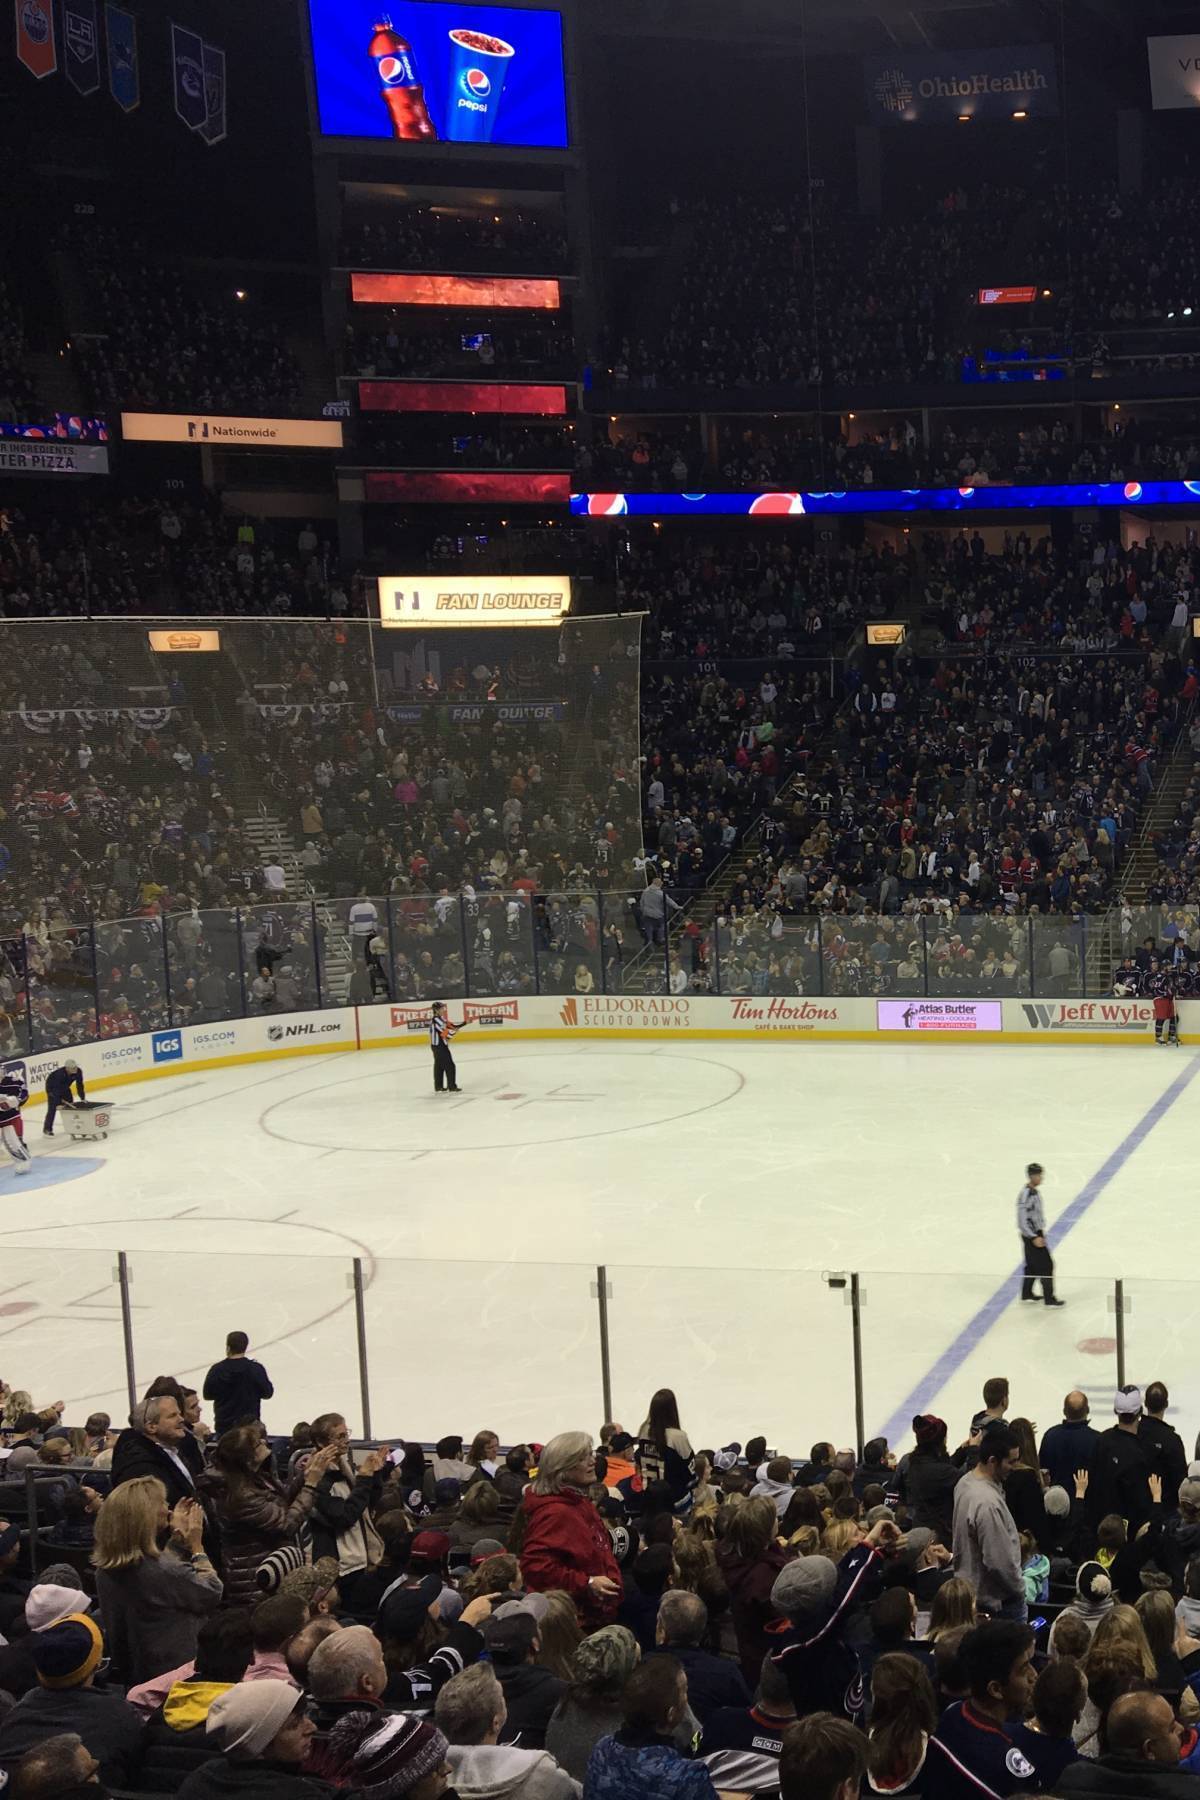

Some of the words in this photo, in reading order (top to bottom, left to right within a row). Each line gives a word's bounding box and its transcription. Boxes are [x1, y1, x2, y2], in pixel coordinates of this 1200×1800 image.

[918, 69, 1048, 98] OhioHealth
[458, 98, 488, 113] pepsi
[212, 426, 276, 438] Nationwide
[32, 455, 78, 469] PIZZA.
[166, 479, 185, 489] 101
[436, 593, 478, 609] FAN
[482, 593, 563, 609] LOUNGE
[698, 662, 717, 673] 101
[1016, 657, 1036, 668] 102
[452, 708, 483, 720] FAN
[584, 998, 690, 1013] ELDORADO
[730, 998, 764, 1019] Tim
[919, 1005, 943, 1014] Atlas
[945, 1005, 977, 1014] Butler
[1060, 1003, 1096, 1022] Jeff
[584, 1015, 638, 1026] SCIOTO
[649, 1015, 690, 1026] DOWNS
[285, 1022, 341, 1037] NHL.COM
[193, 1031, 235, 1044] IGS.COM
[156, 1039, 179, 1053] IGS
[102, 1046, 142, 1061] IGS.COM
[30, 1061, 58, 1074] WATCH
